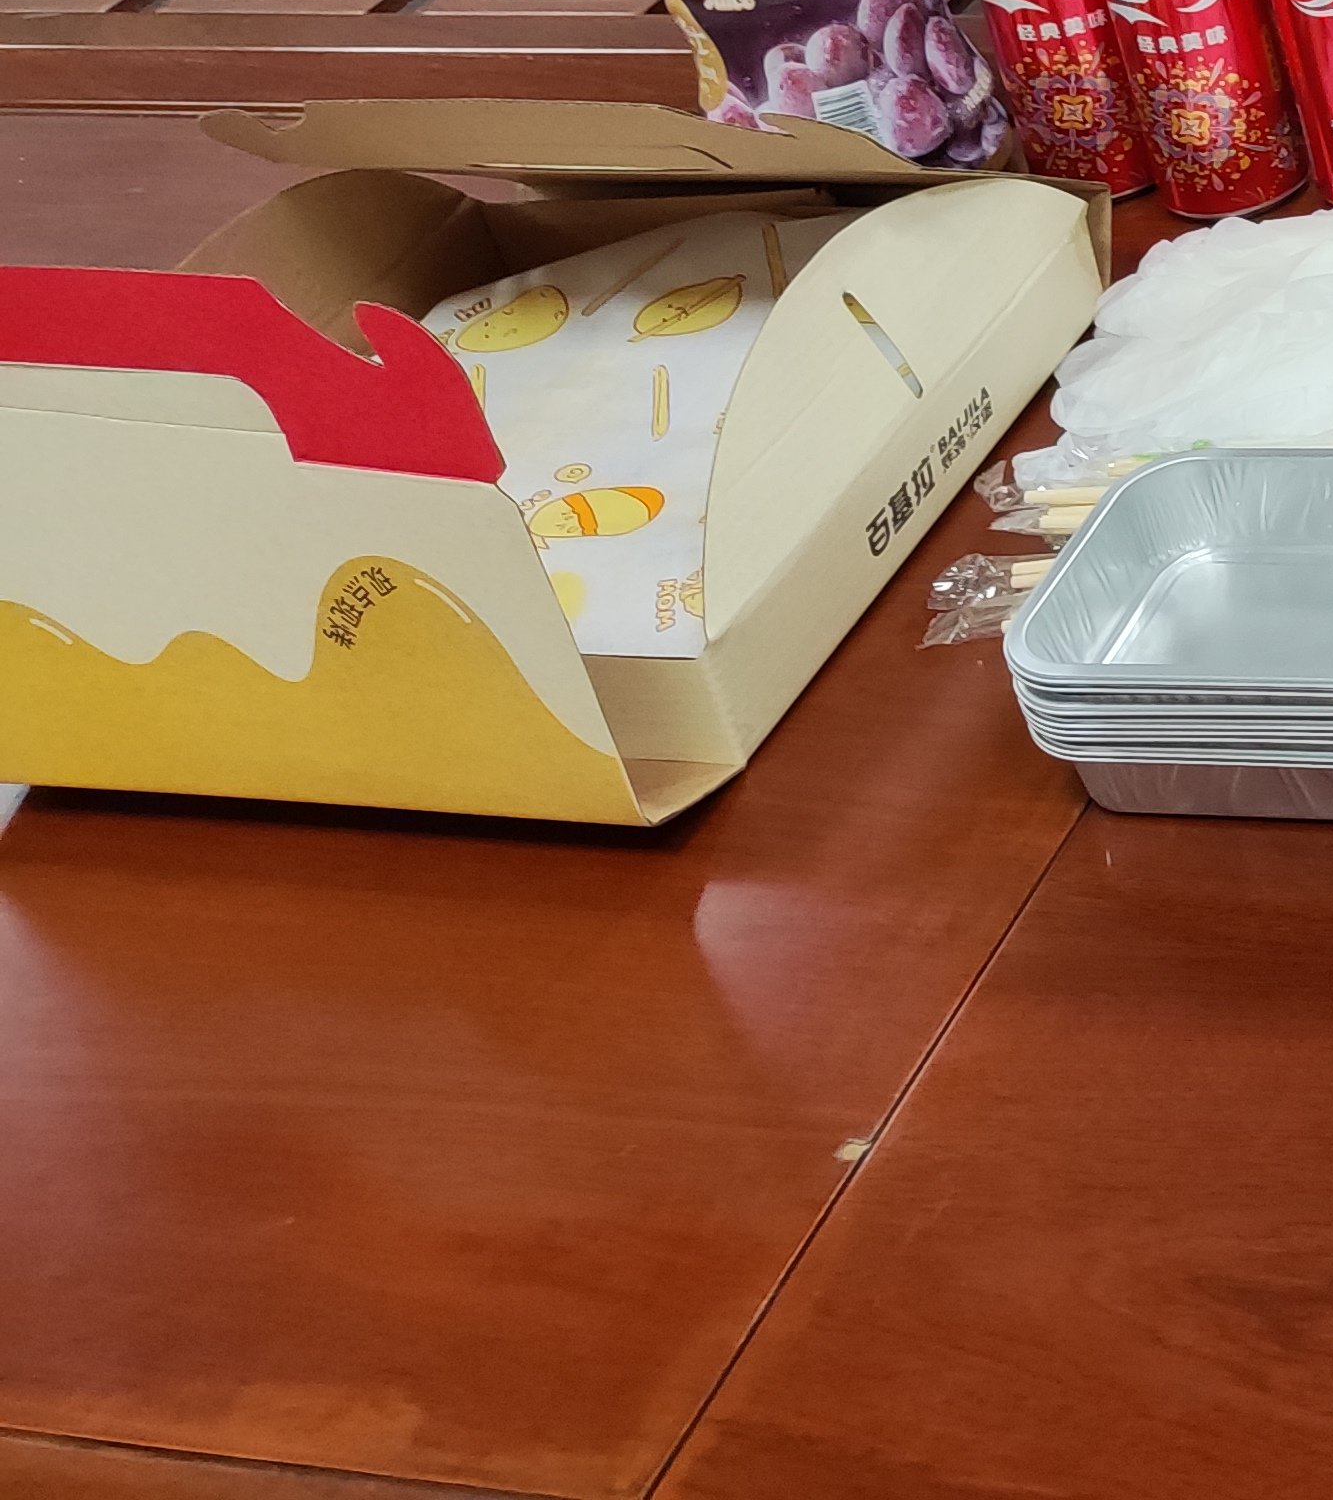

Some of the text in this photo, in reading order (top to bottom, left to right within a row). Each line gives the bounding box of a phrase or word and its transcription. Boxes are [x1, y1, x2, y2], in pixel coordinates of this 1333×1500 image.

[1136, 25, 1229, 54] 经典美味
[937, 386, 991, 456] BAIJILA
[865, 455, 936, 558] 百基拉
[322, 566, 398, 650] 现点现烤
